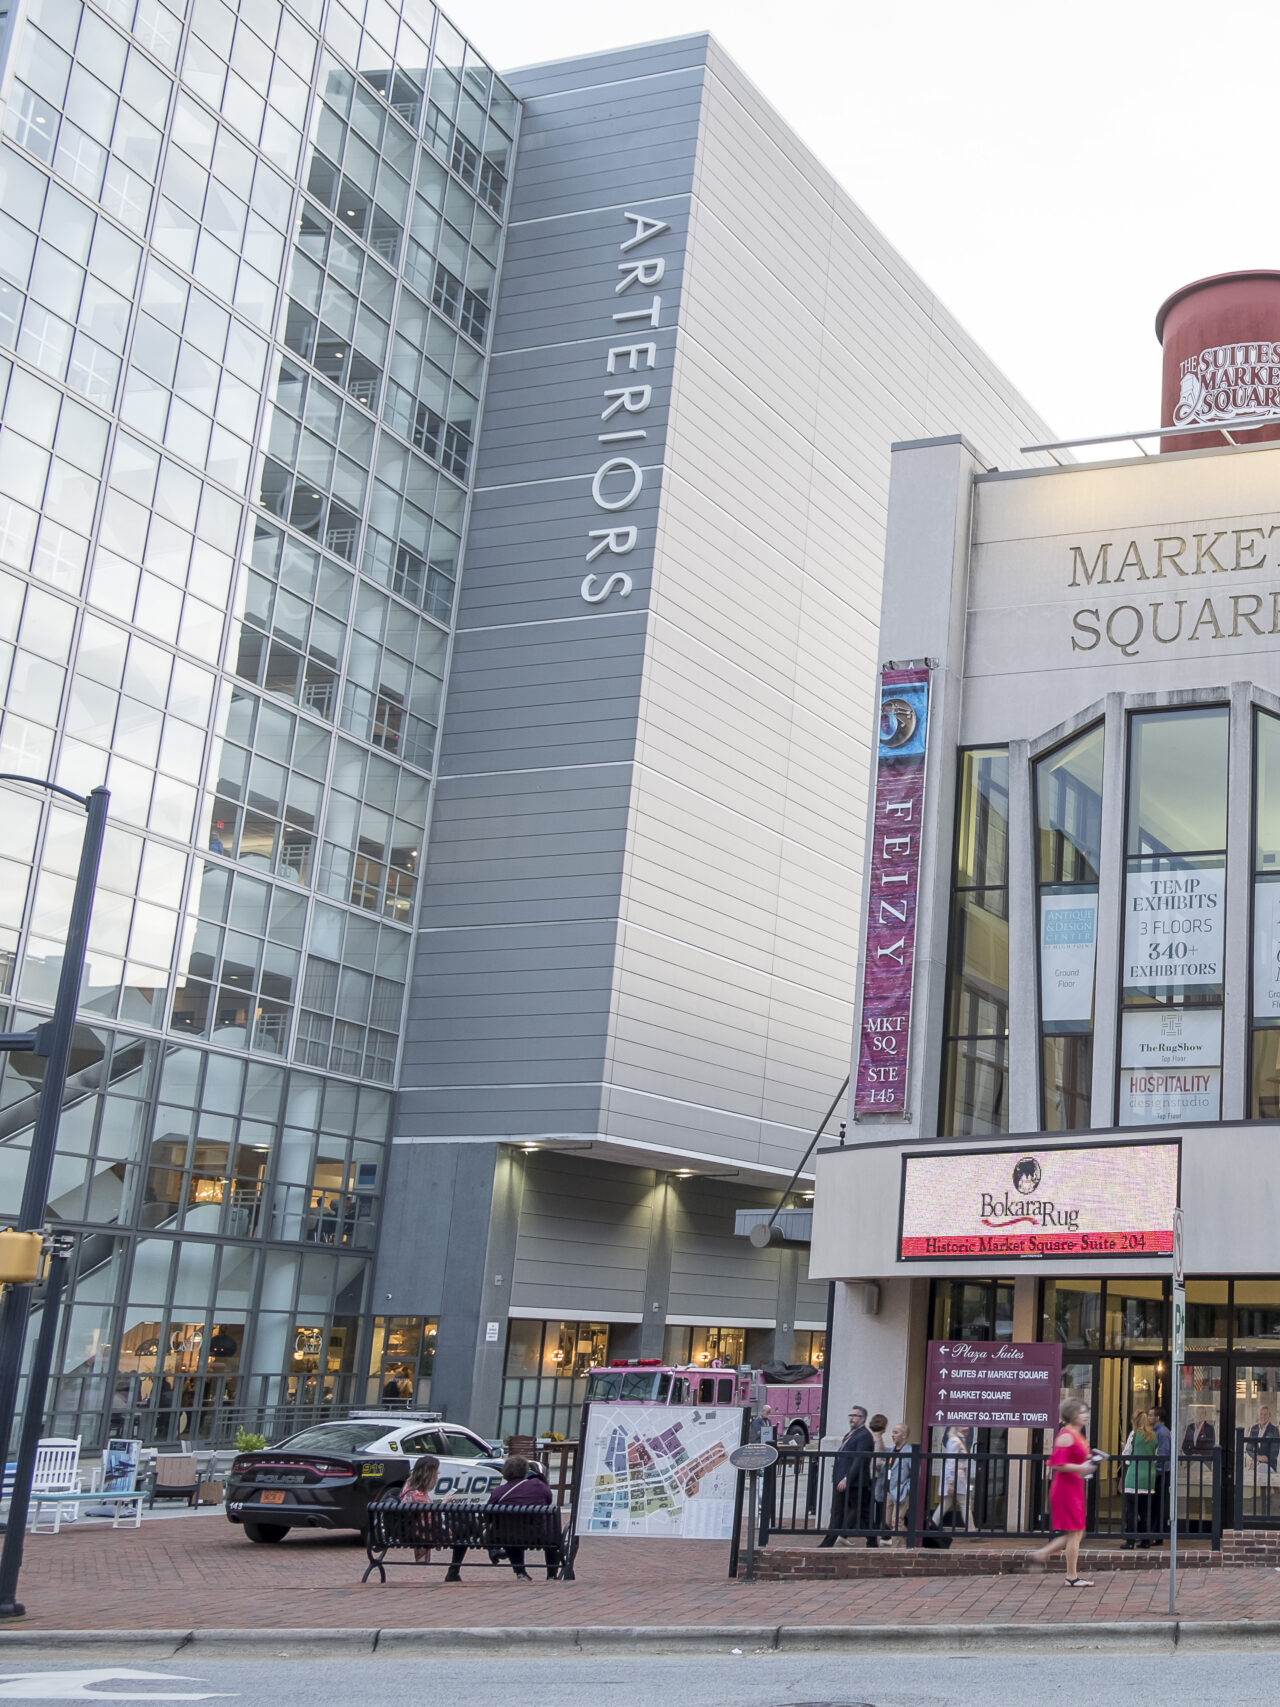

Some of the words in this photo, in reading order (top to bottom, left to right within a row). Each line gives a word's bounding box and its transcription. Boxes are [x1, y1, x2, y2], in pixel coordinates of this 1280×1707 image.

[1179, 356, 1198, 378] THE
[580, 211, 671, 604] ARTERIORS
[877, 798, 913, 966] FEIZY
[1150, 879, 1201, 895] TEMP
[1133, 893, 1218, 912] EXHIBITS
[1047, 911, 1093, 921] ANTIQUE
[1140, 921, 1148, 935] 3
[1153, 919, 1213, 934] FLOORS
[1148, 942, 1198, 960] 340+
[1055, 969, 1080, 978] Ground
[1130, 962, 1217, 978] EXHIBITORS
[1058, 980, 1076, 988] Floor
[866, 1017, 905, 1032] MKT
[873, 1035, 898, 1054] SQ
[867, 1066, 899, 1082] STE
[1129, 1075, 1211, 1093] HOSPITALITY
[870, 1089, 895, 1103] 145
[925, 1238, 975, 1253] Historic
[979, 1236, 1025, 1252] Market
[1081, 1234, 1116, 1250] Suite
[1121, 1234, 1145, 1250] 204
[952, 1343, 988, 1363] Plaza
[991, 1344, 1025, 1359] Suites
[951, 1370, 977, 1378] SUITES
[978, 1370, 987, 1378] AT
[987, 1371, 1018, 1379] MARKET
[1018, 1371, 1049, 1379] SQUARE
[949, 1391, 980, 1399] MARKET
[981, 1391, 1012, 1400] SQUARE
[947, 1411, 978, 1420] MARKET
[978, 1412, 991, 1421] SQ.
[991, 1412, 1021, 1421] TEXTILE
[1021, 1412, 1049, 1421] TOWER
[362, 1463, 385, 1474] 911
[255, 1474, 306, 1484] POLICE
[434, 1476, 503, 1496] OLICE
